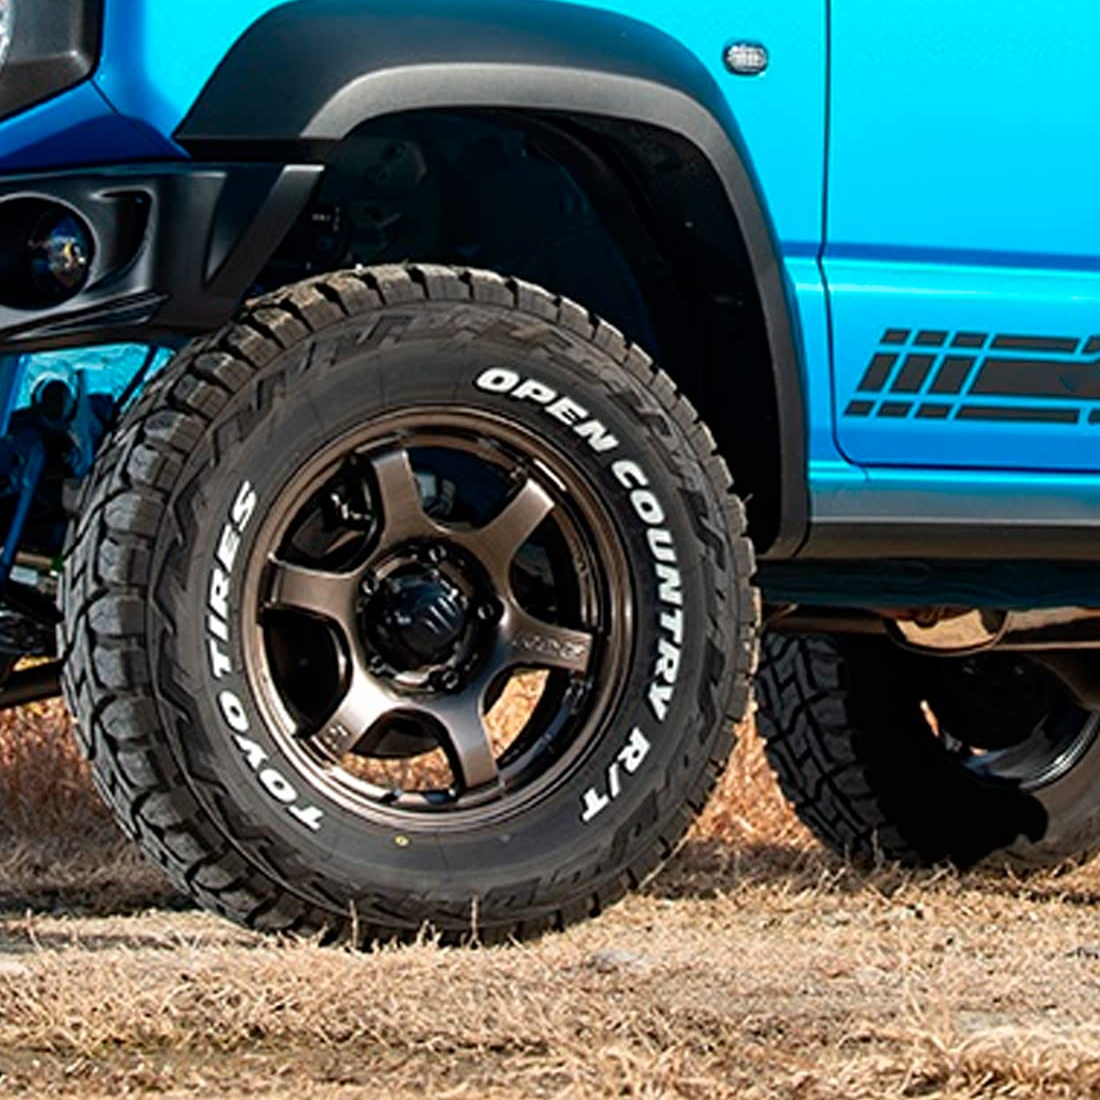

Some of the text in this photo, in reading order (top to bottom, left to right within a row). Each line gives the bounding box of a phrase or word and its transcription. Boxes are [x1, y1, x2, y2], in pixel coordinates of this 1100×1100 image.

[208, 480, 324, 831] TOYO TIRES
[476, 367, 683, 822] OPEN COUNTRY R/T
